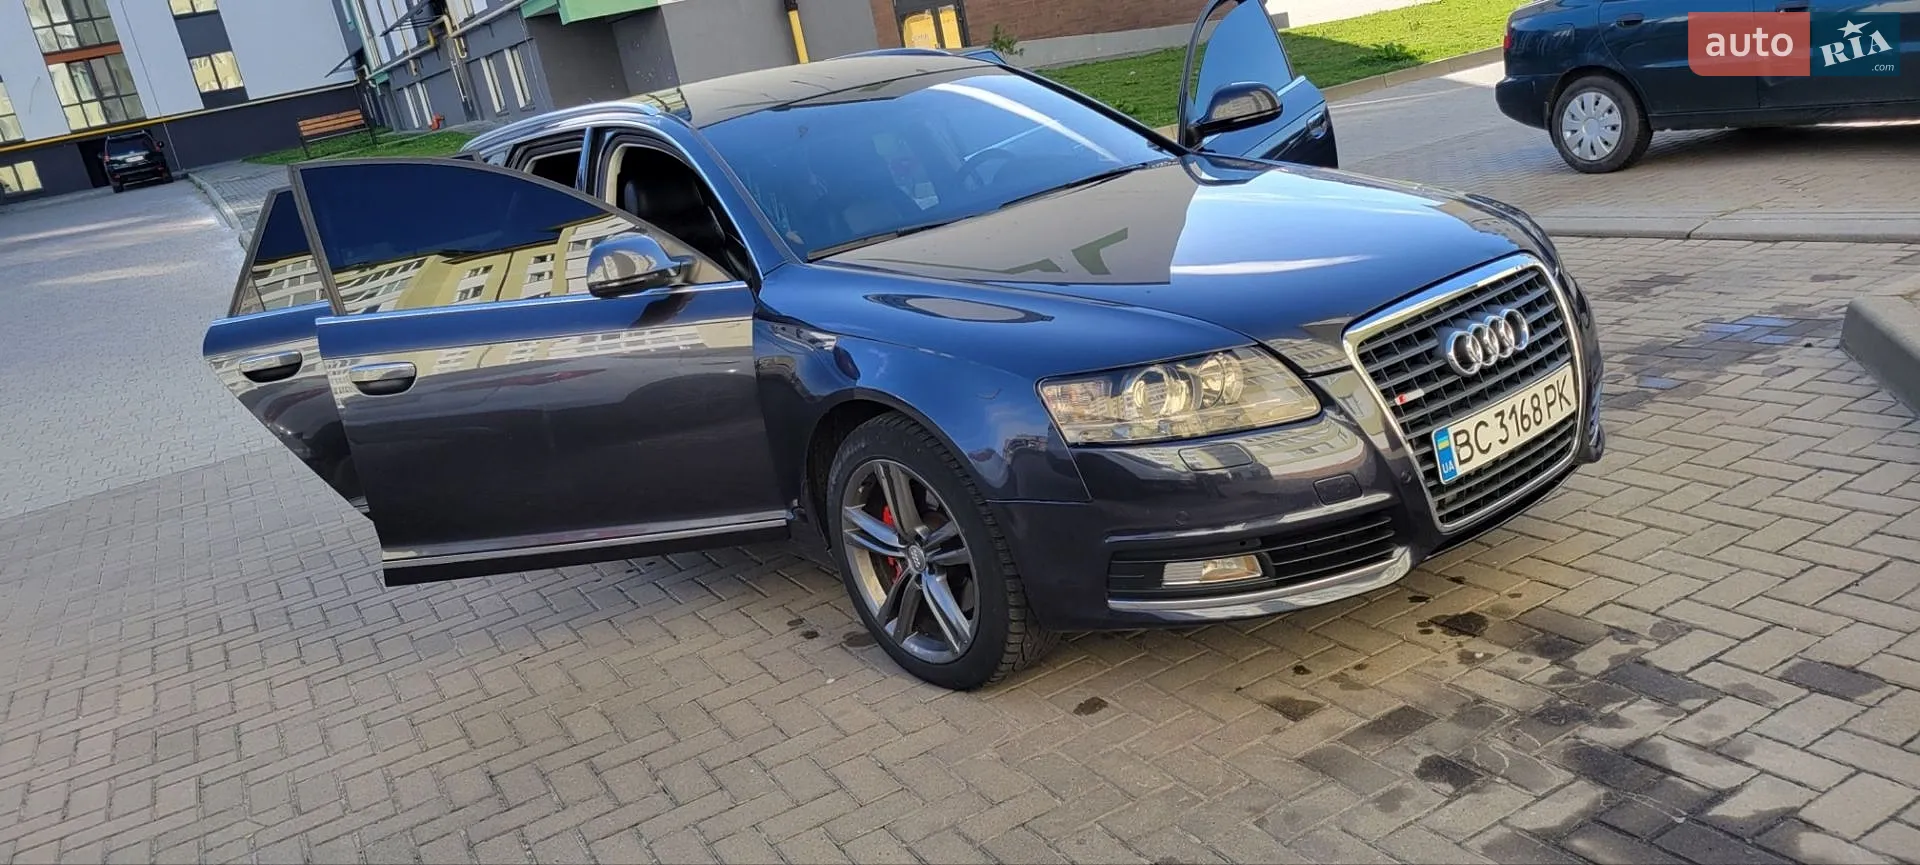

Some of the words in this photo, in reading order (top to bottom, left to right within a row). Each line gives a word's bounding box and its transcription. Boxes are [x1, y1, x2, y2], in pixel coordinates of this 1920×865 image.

[1453, 420, 1492, 466] BC
[1494, 393, 1543, 445] 3168
[1544, 375, 1572, 419] PK
[1442, 462, 1455, 474] UA
